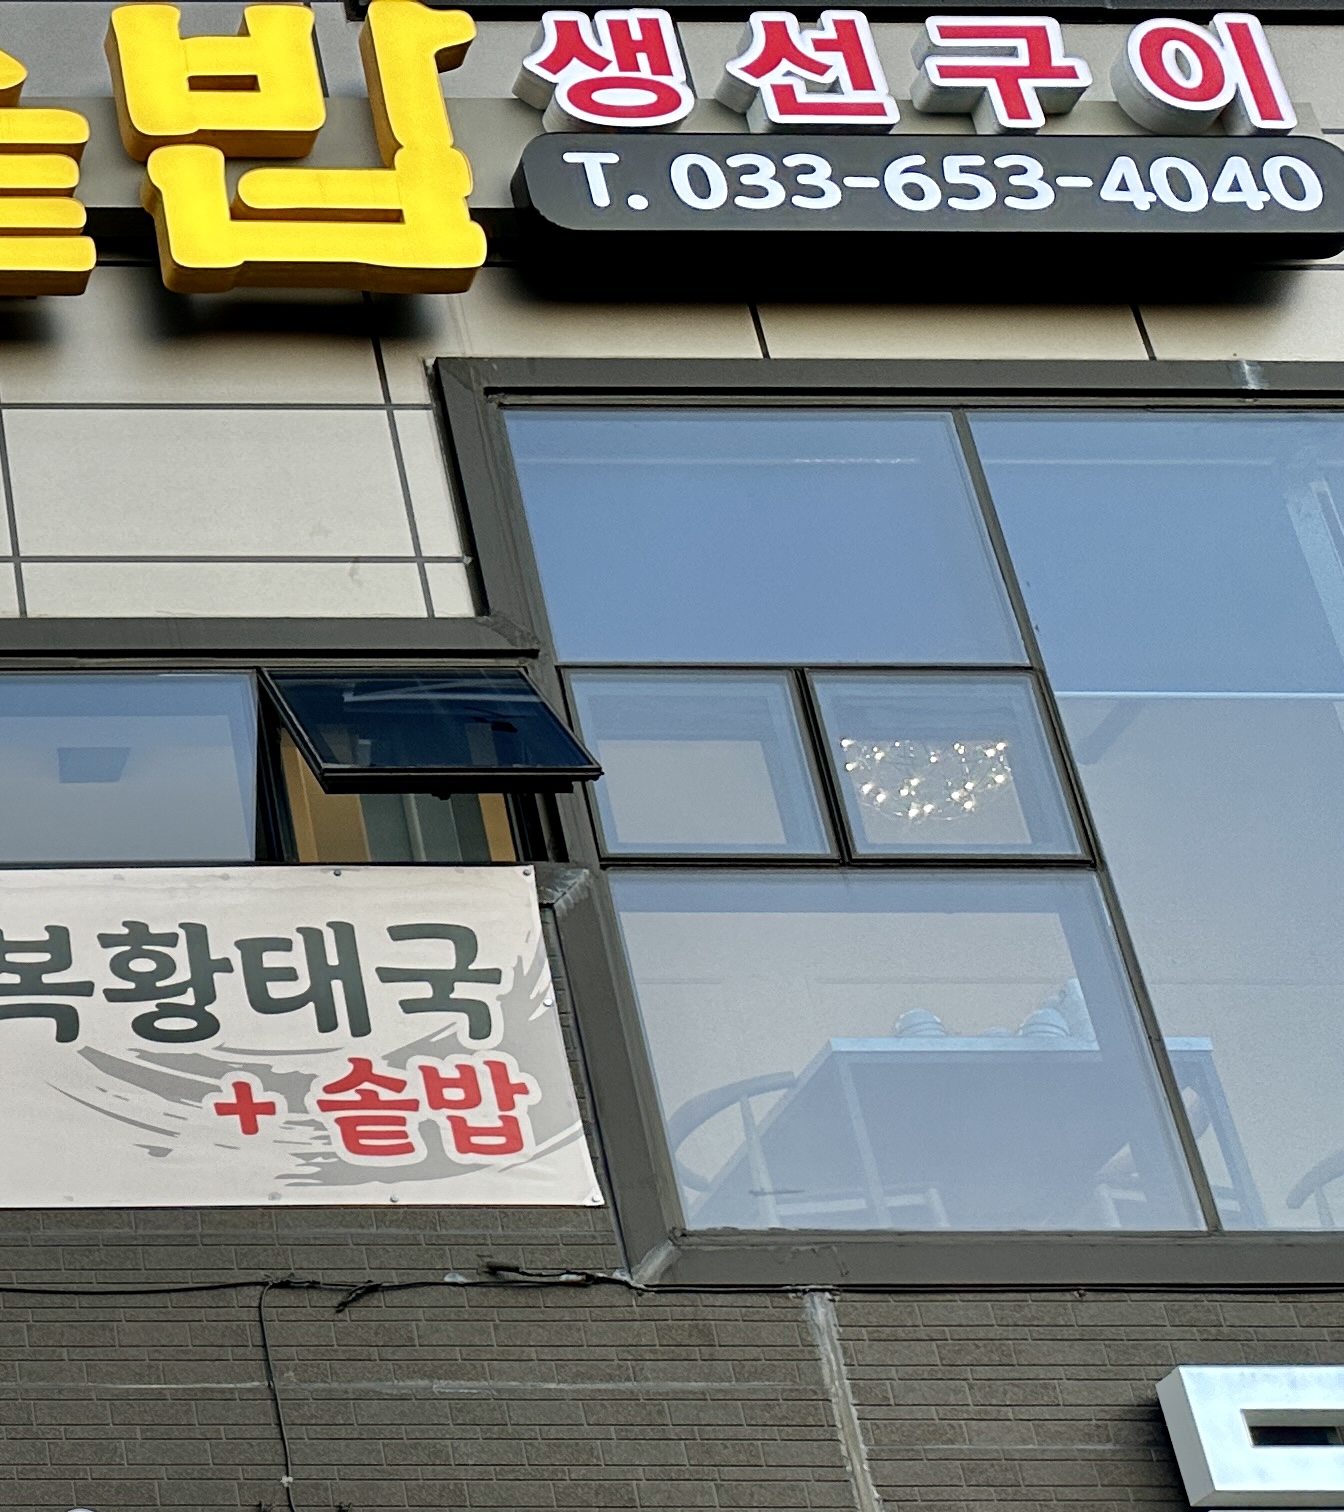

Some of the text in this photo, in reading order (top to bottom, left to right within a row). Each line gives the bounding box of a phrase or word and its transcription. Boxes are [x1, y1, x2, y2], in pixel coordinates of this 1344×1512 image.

[530, 12, 1294, 132] 생선구이
[562, 152, 1324, 213] T. 033-653-4040
[315, 1058, 531, 1157] 솥밥
